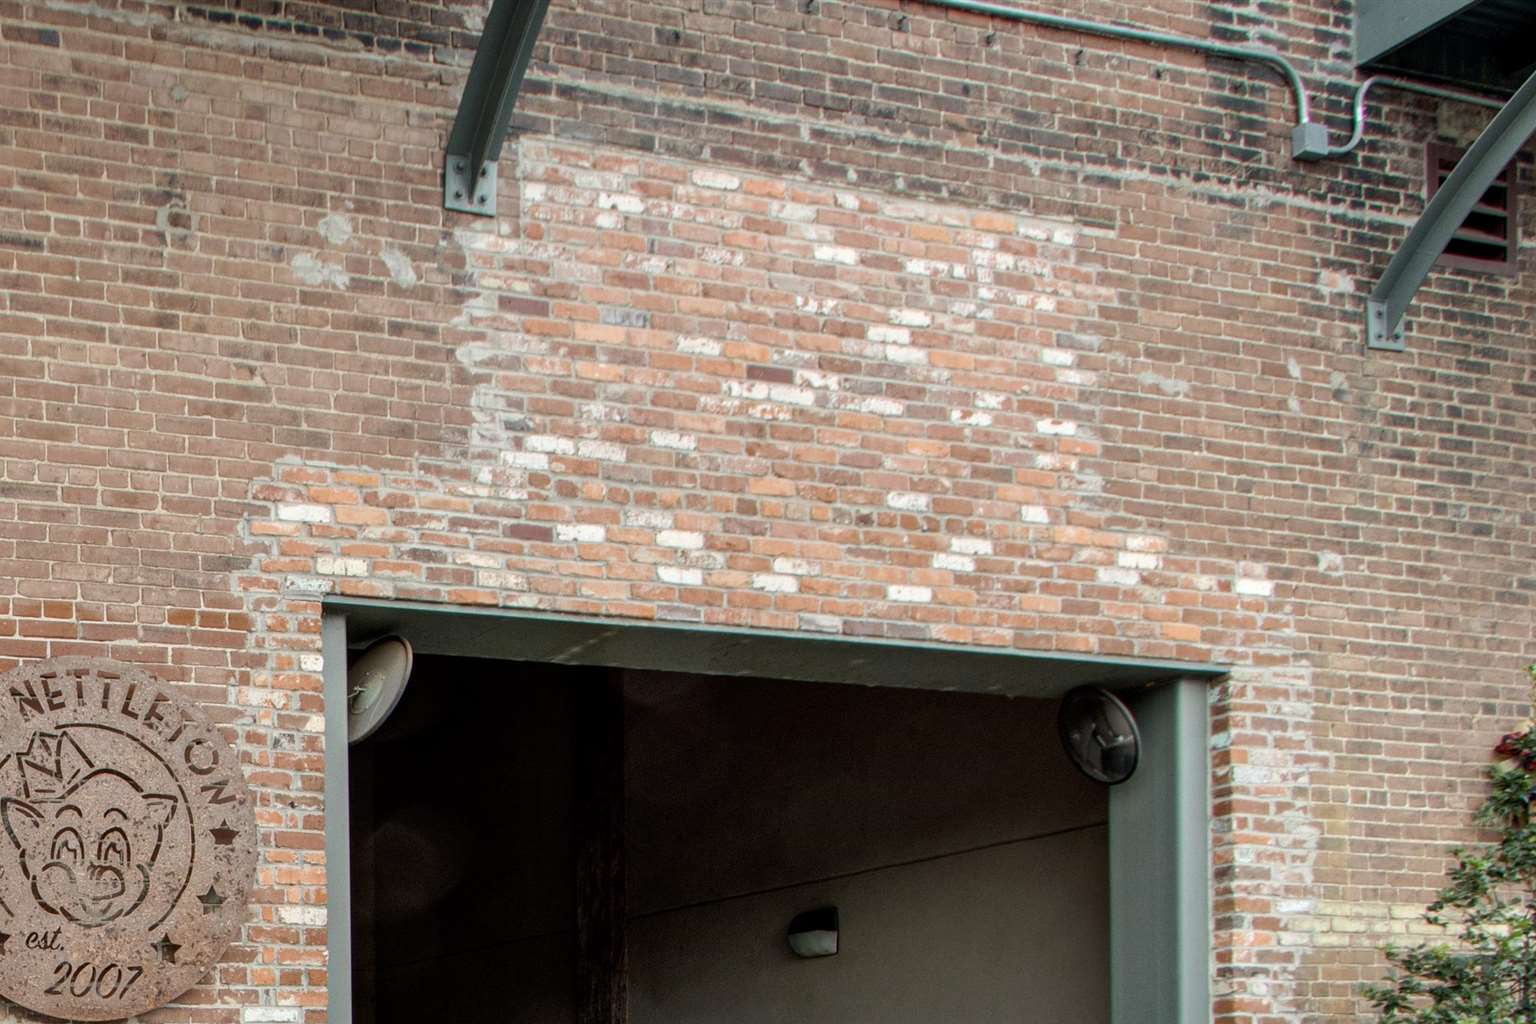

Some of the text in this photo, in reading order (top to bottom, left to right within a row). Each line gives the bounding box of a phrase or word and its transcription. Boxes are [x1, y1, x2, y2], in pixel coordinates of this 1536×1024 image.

[8, 668, 238, 806] NETTLETON
[24, 926, 65, 951] est.
[44, 961, 144, 1000] 2007
